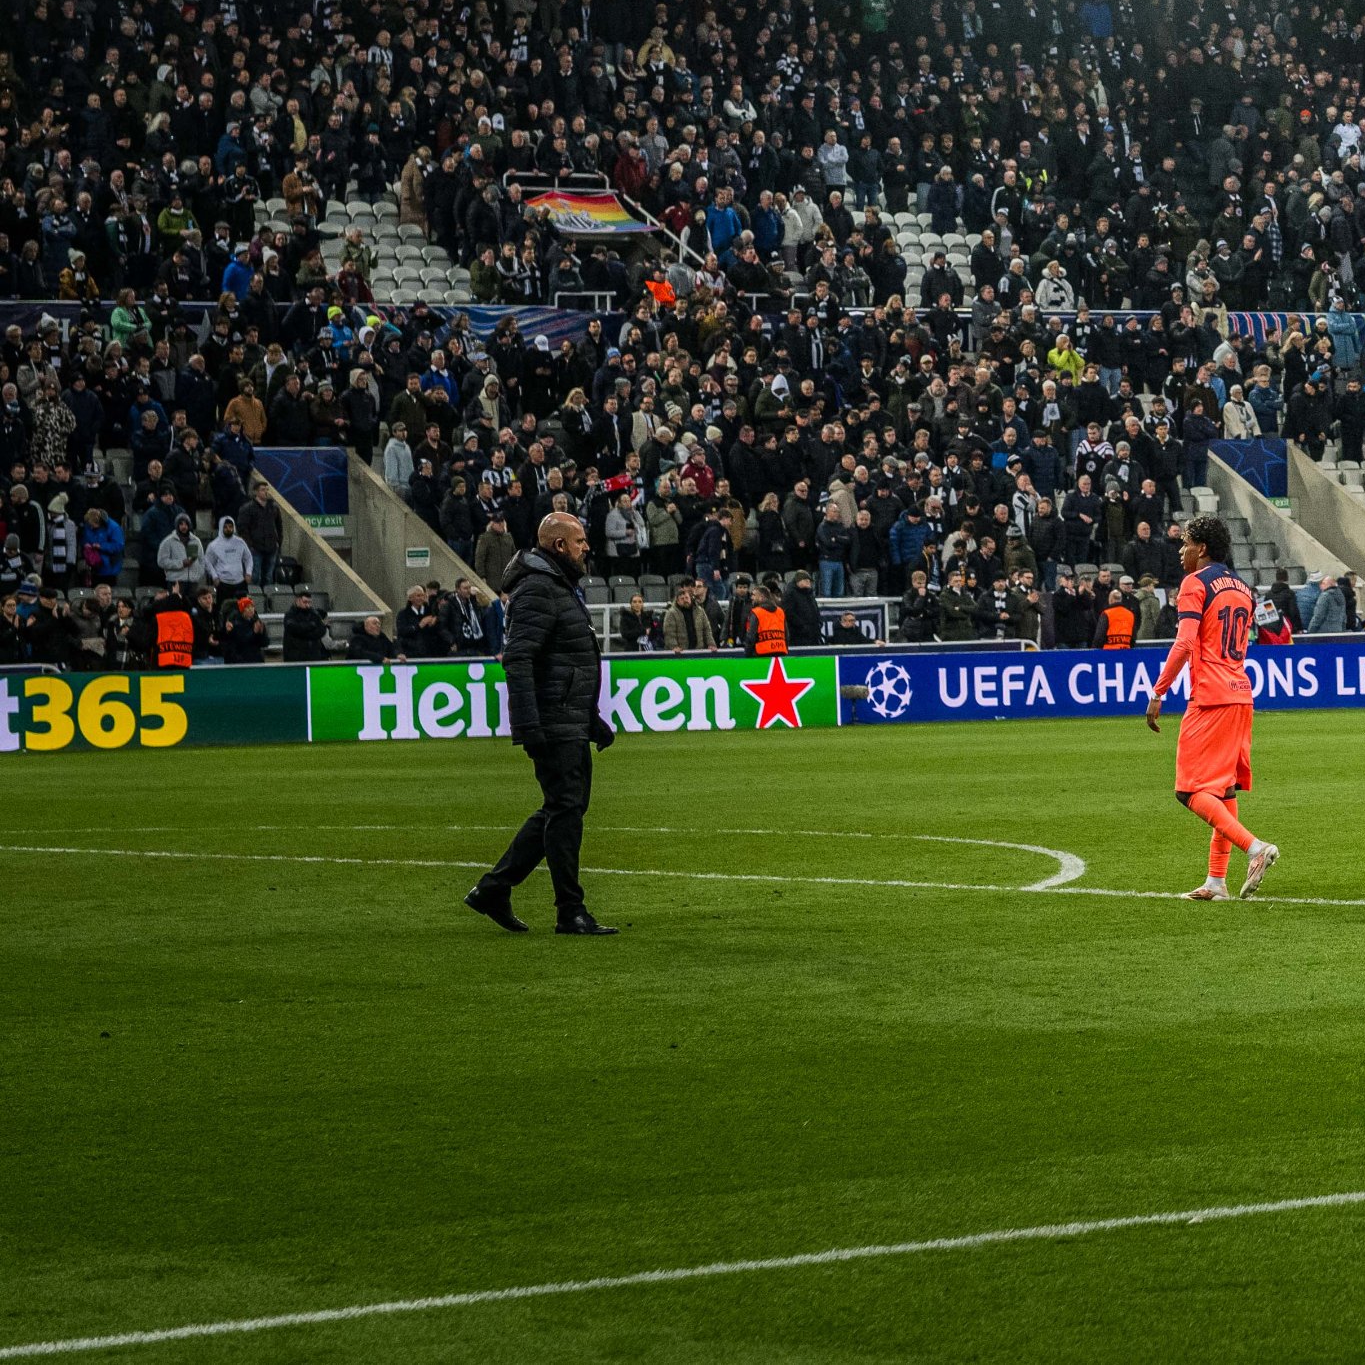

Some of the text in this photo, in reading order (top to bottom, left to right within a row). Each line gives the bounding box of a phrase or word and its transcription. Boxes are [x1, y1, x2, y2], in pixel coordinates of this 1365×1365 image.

[325, 516, 343, 525] exit
[1217, 605, 1249, 661] 10
[356, 660, 736, 740] Heiken
[938, 664, 1056, 708] UEFA
[1068, 656, 1319, 704] CHAMONS
